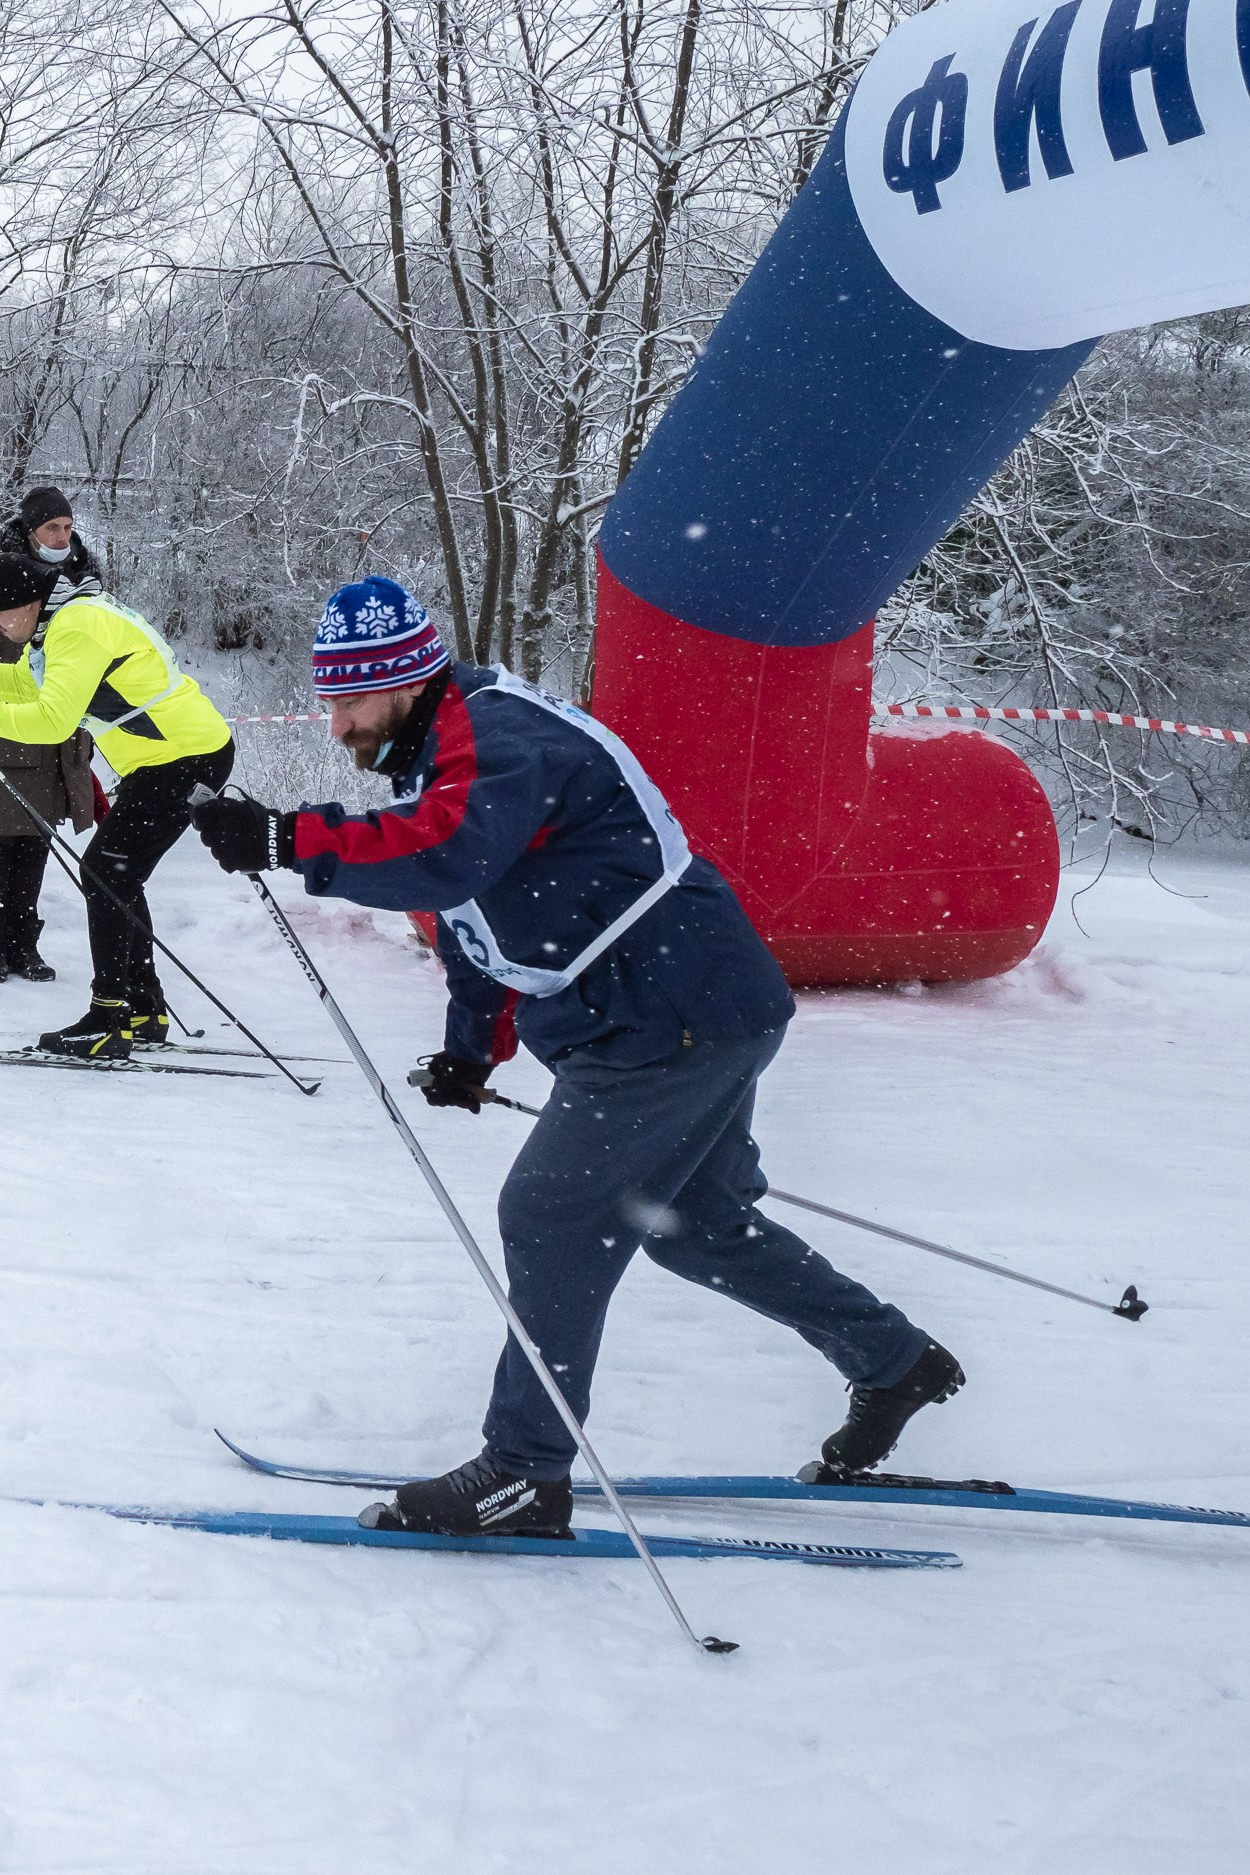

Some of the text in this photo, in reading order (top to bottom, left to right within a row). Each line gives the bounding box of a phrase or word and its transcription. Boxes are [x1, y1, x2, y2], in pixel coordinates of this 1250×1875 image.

[883, 0, 1250, 215] ФИН
[268, 815, 278, 869] NORDWAY
[475, 1478, 527, 1512] NORDWAY
